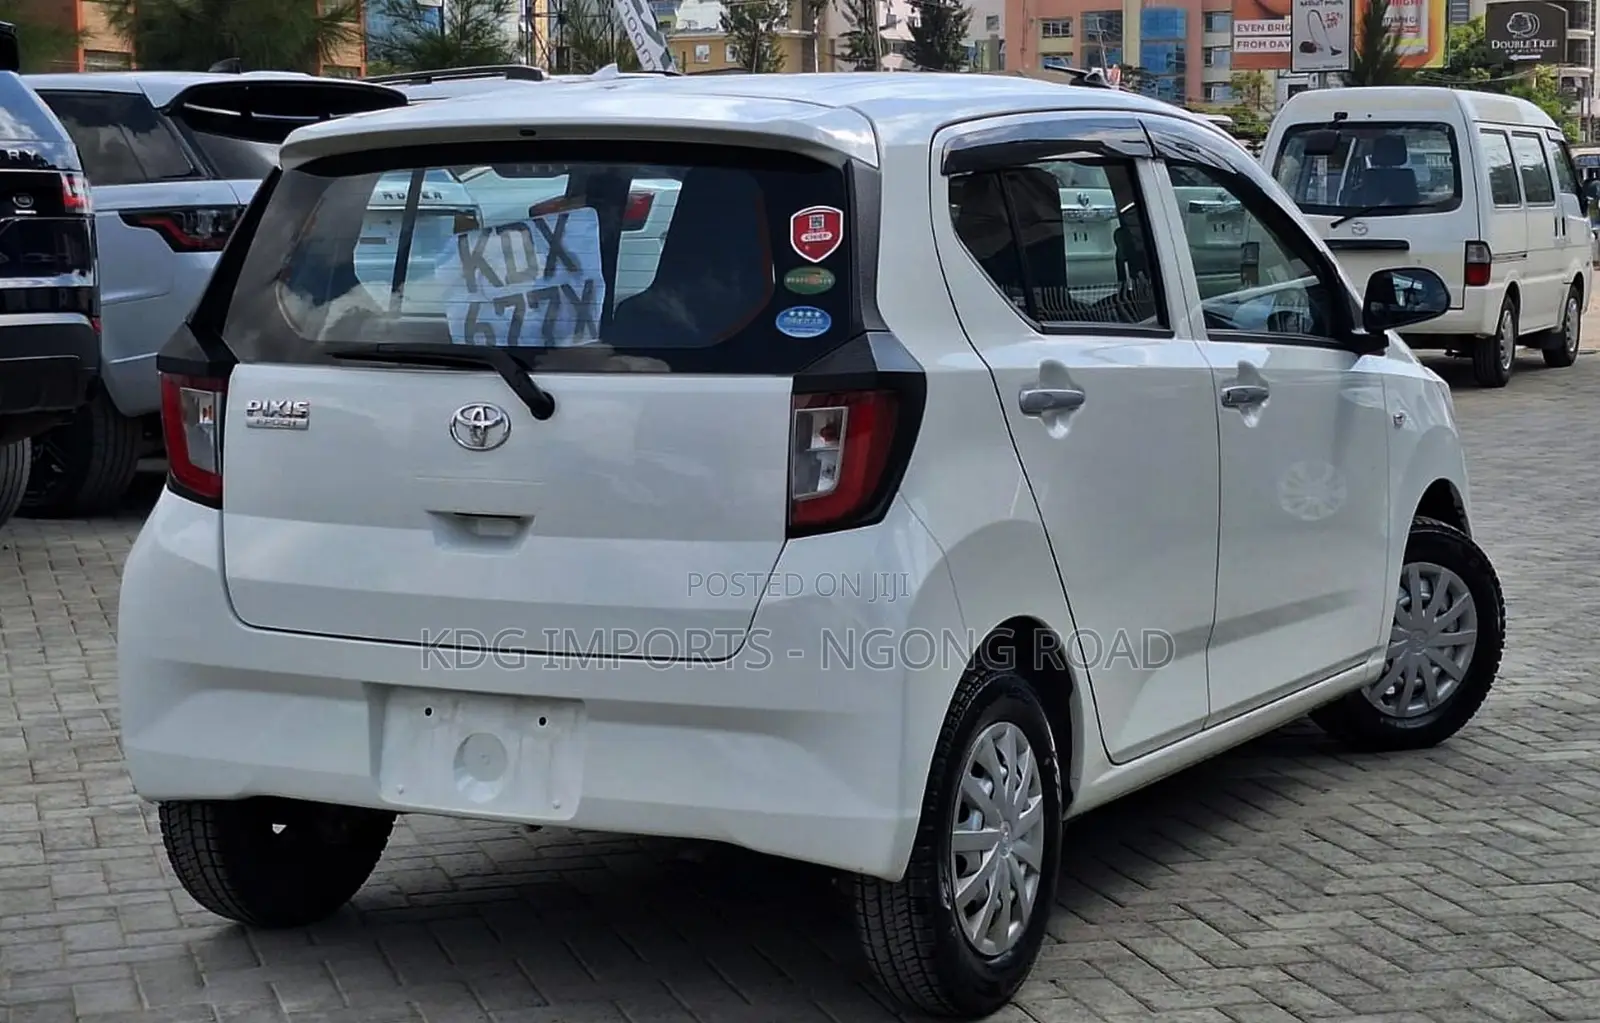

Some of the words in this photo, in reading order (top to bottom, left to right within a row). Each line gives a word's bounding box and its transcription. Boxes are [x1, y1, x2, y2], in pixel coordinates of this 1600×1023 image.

[1237, 23, 1265, 32] EVEN
[1237, 40, 1266, 49] FROM
[382, 191, 443, 200] ROER
[457, 213, 583, 294] KDX
[246, 399, 309, 418] PIXIS
